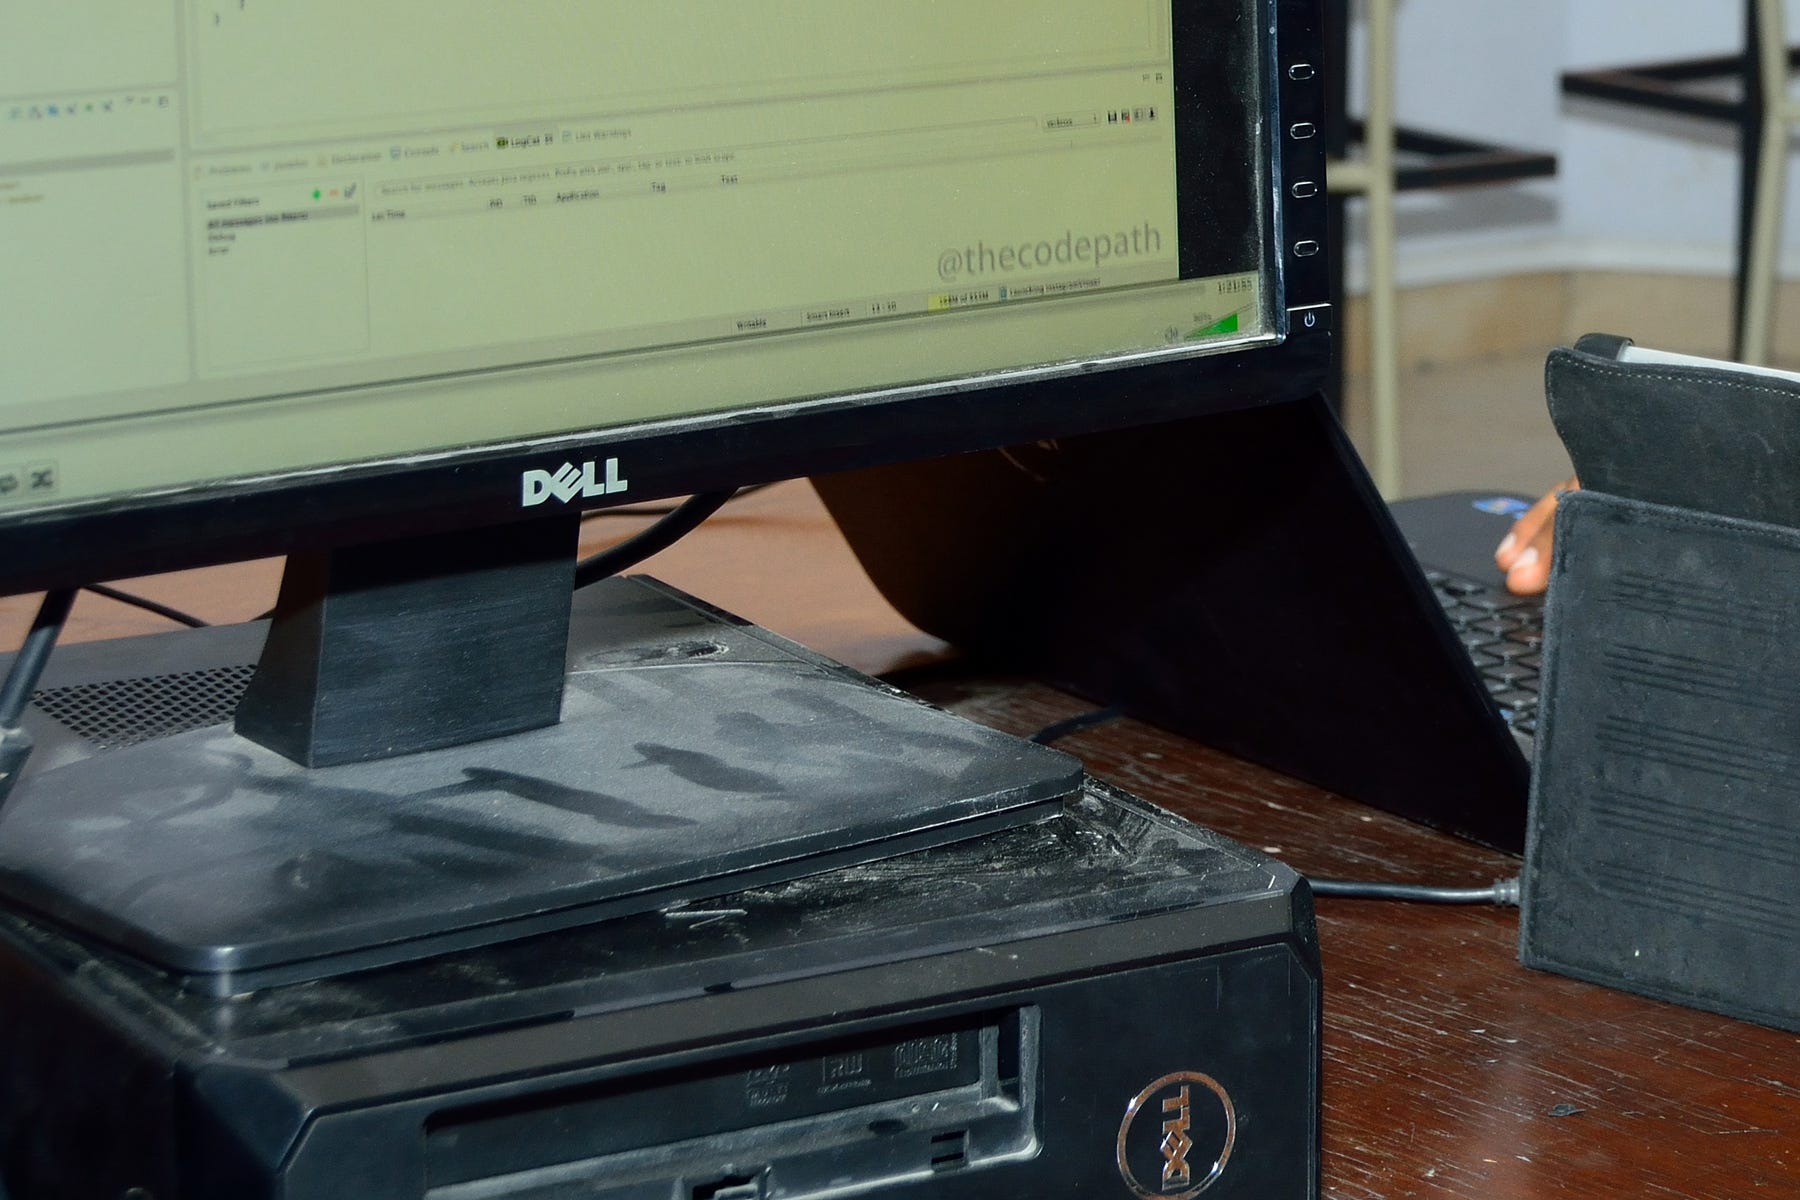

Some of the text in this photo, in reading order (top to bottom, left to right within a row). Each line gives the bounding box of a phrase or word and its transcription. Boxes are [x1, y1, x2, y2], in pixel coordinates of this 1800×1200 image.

[511, 136, 540, 149] LogCat
[720, 174, 738, 184] Text
[651, 181, 666, 193] Tag
[555, 190, 599, 204] Application
[938, 222, 1162, 282] @thecodepath
[522, 457, 628, 508] DELL
[1160, 1085, 1193, 1191] DELL
